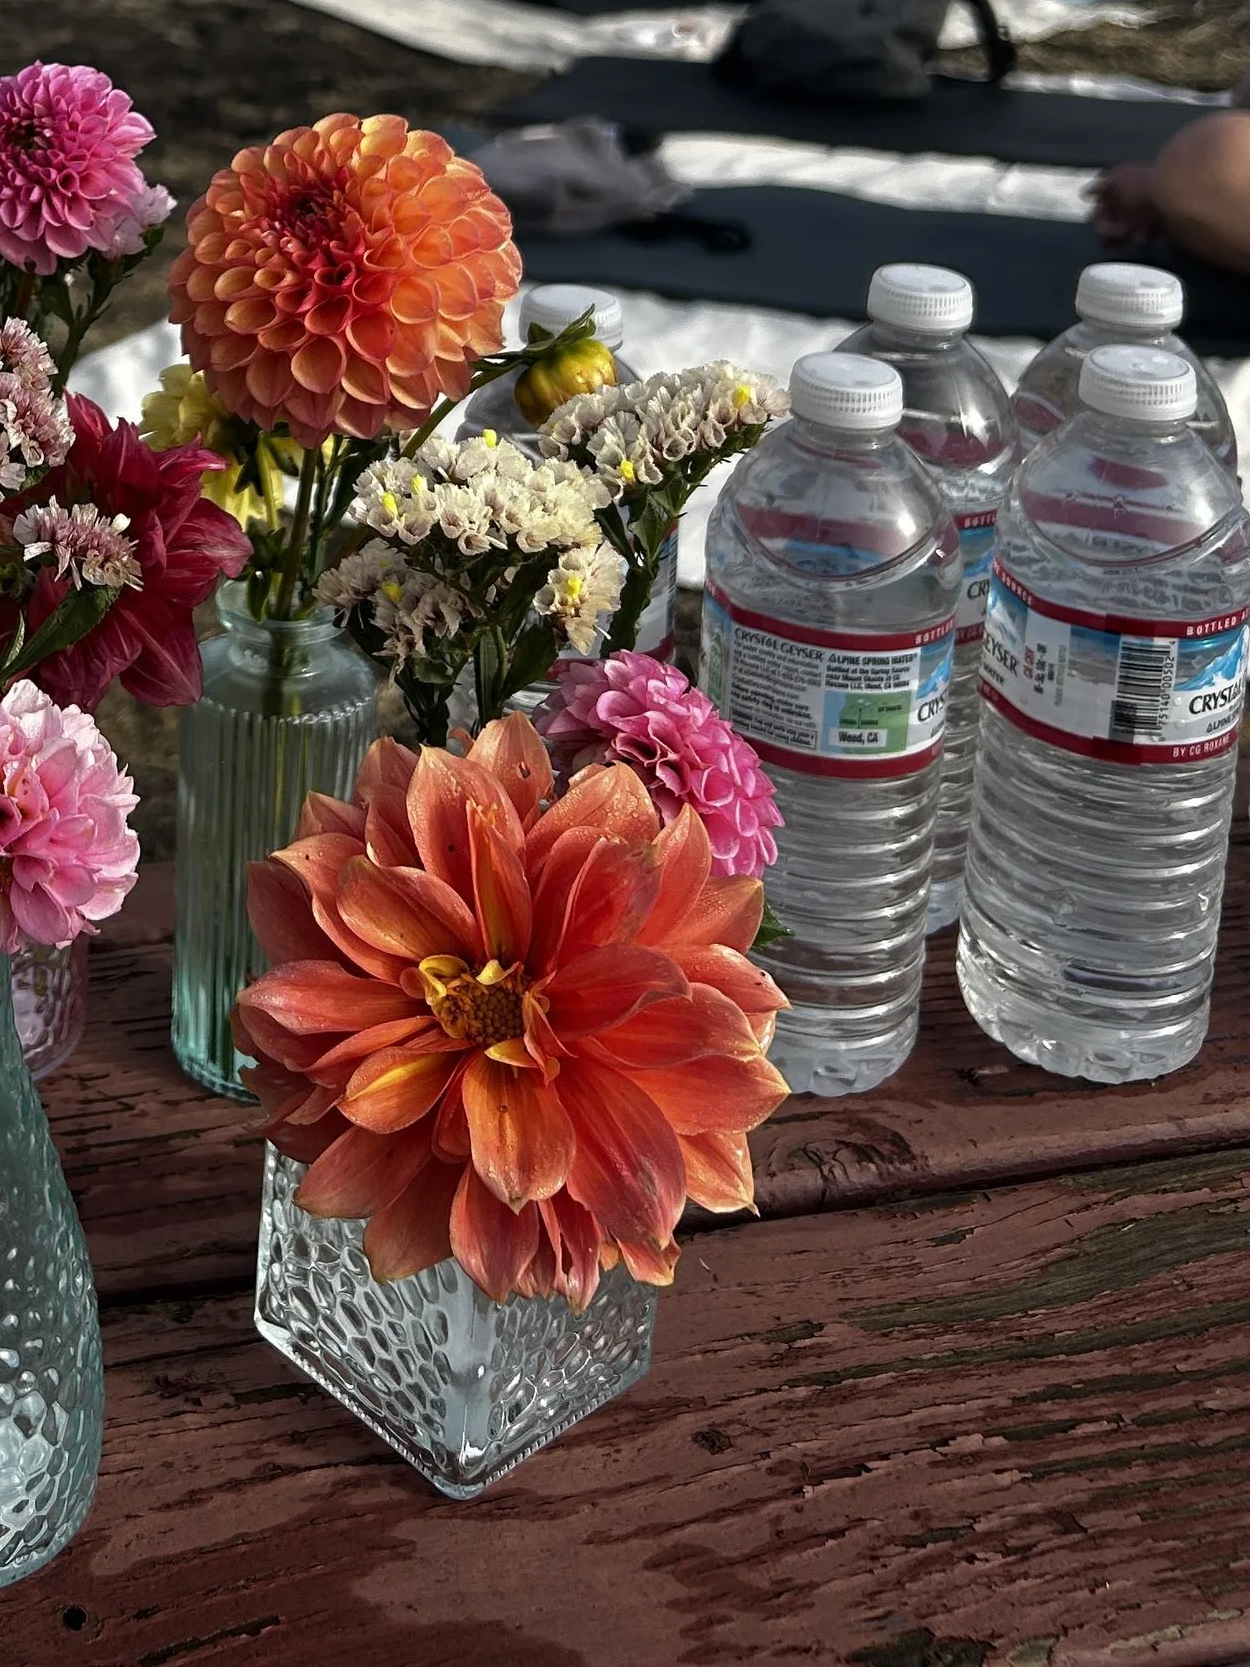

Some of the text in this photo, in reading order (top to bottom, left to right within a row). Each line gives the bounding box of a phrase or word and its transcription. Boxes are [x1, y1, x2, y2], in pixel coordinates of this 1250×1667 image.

[1186, 617, 1237, 636] BOTTLED
[734, 627, 778, 651] CRYSTAL
[780, 642, 823, 662] GEYSER
[838, 731, 878, 745] Weed, CA
[1173, 732, 1230, 758] BY CG ROXANE
